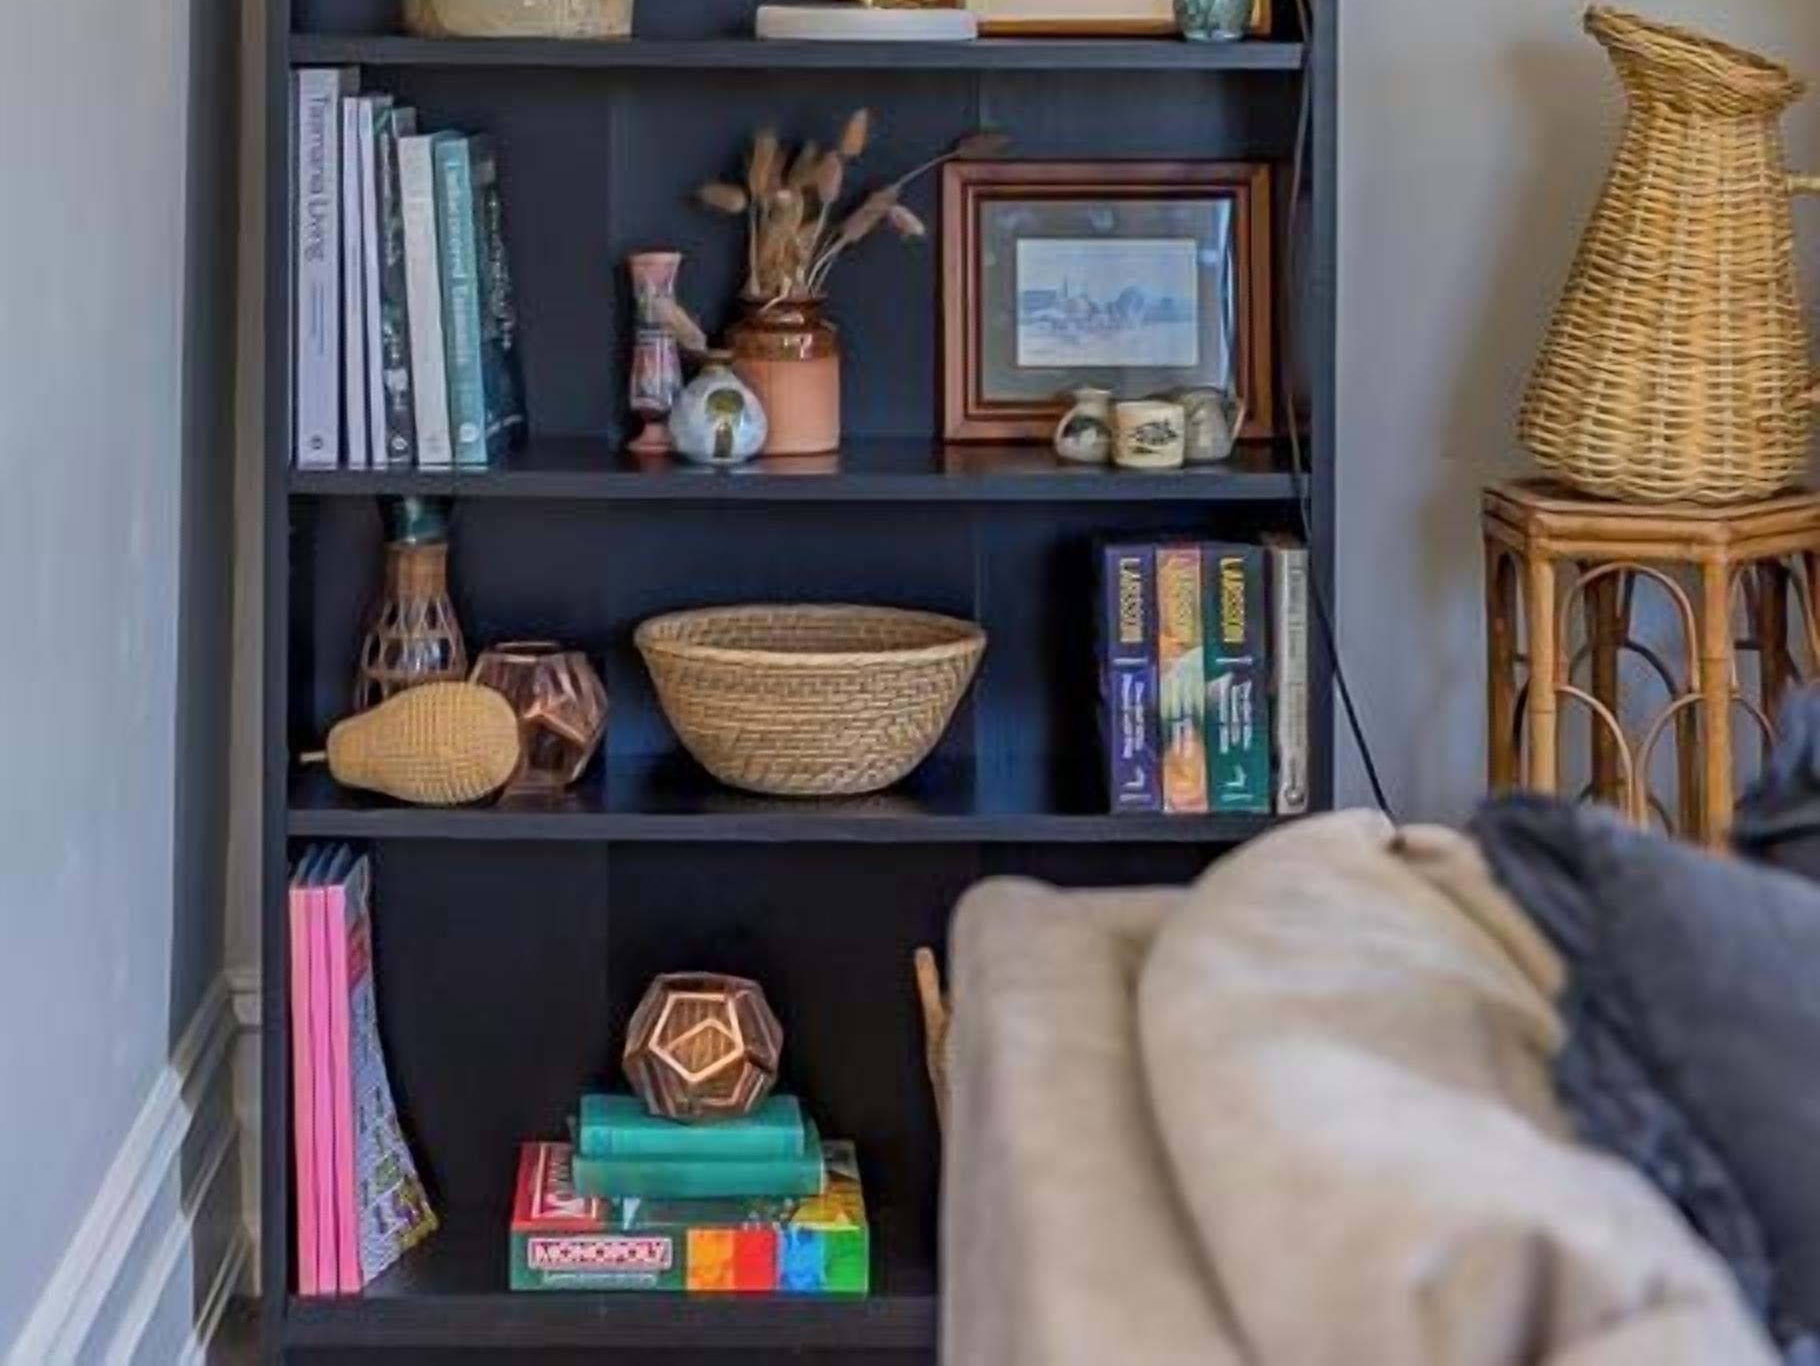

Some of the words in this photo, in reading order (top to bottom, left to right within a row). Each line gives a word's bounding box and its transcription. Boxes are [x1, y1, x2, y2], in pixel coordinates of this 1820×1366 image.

[308, 95, 329, 196] Tasmania
[303, 200, 329, 263] Living
[534, 1240, 667, 1264] MONOPOLY
